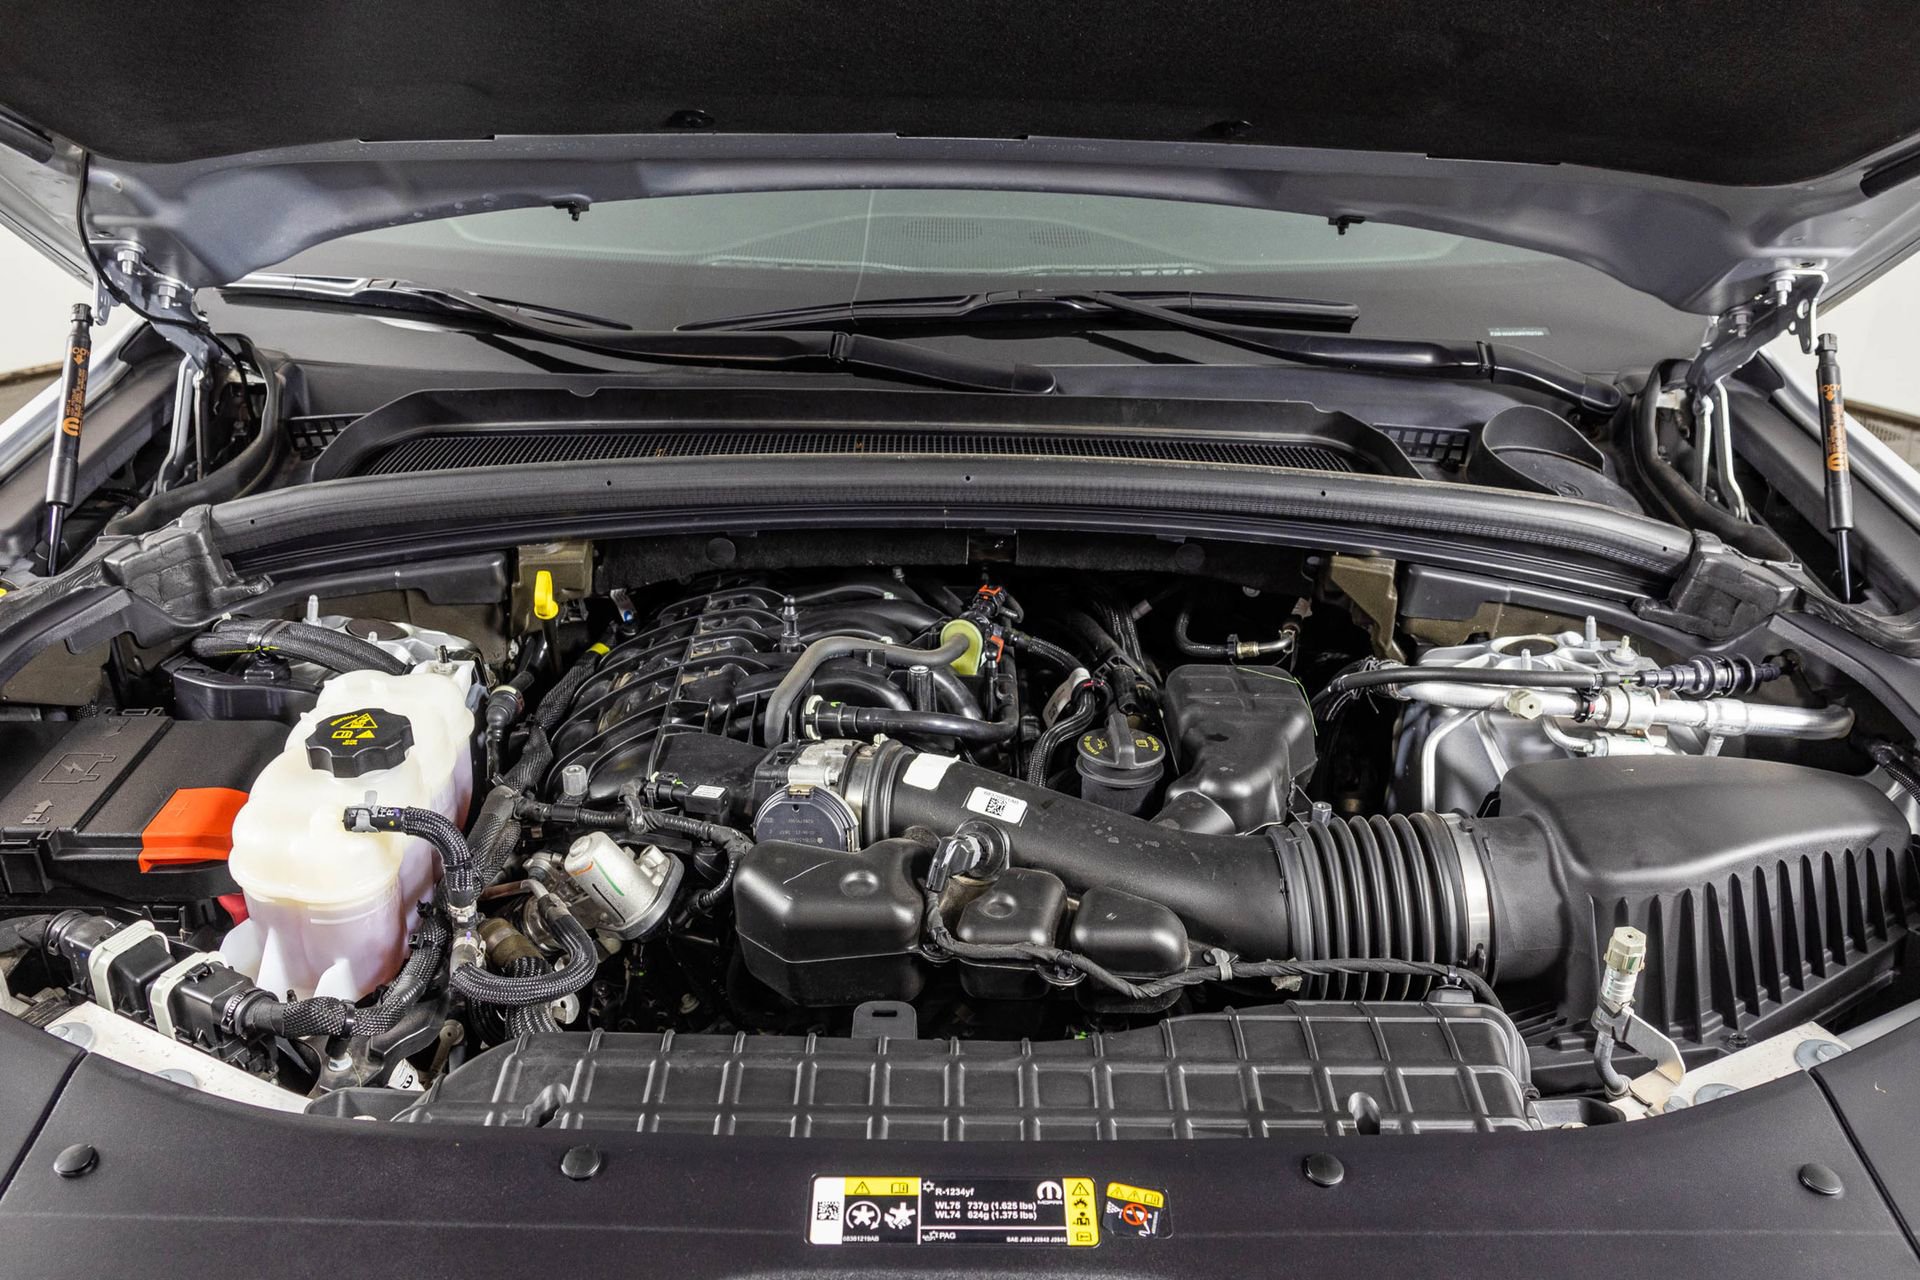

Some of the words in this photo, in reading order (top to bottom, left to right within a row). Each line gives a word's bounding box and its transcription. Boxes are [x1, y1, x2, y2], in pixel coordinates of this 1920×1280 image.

[935, 1187, 975, 1197] R-1234yf
[935, 1201, 961, 1210] WL75
[967, 1201, 990, 1211] 737g
[1019, 1201, 1037, 1212] lbs)
[935, 1211, 961, 1219] WL74
[967, 1211, 990, 1221] 624g
[1019, 1211, 1037, 1221] lbs)
[938, 1231, 956, 1240] PAG
